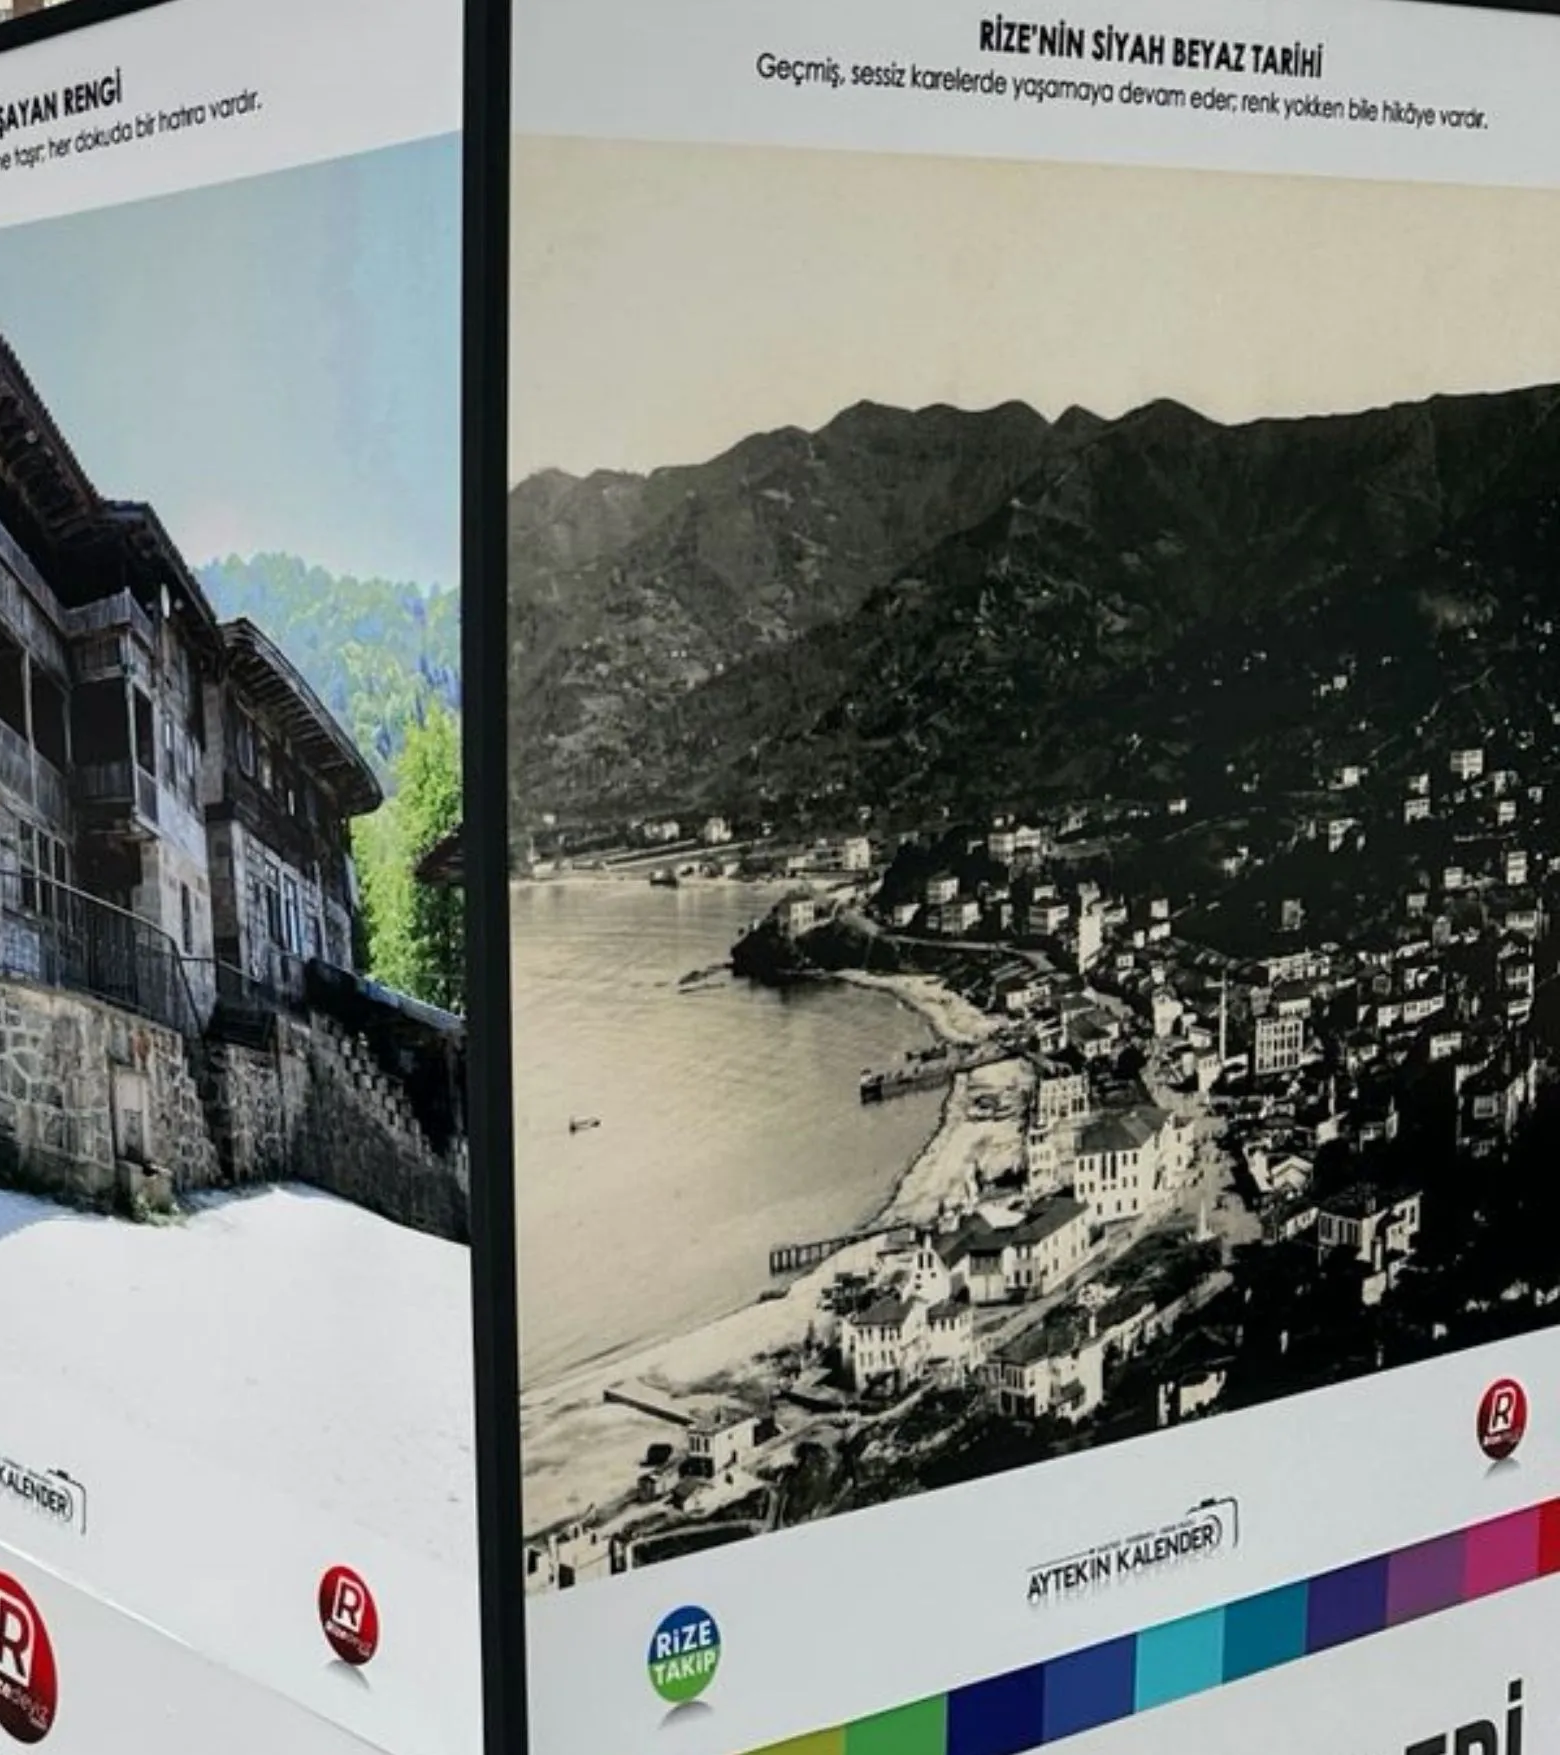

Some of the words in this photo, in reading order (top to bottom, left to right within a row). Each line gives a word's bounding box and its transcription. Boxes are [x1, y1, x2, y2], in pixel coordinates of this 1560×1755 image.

[980, 14, 1085, 60] RİZE'NİN
[1092, 24, 1165, 66] SİYAH
[1172, 37, 1246, 73] BEYAZ
[1252, 42, 1324, 78] TARİHİ
[64, 67, 122, 117] RENGİ
[756, 52, 845, 90] Geçmiş,
[851, 62, 906, 88] sessiz
[910, 64, 1007, 96] karelerde
[1012, 77, 1114, 106] yaşamaya
[1118, 80, 1187, 108] devam
[1241, 92, 1281, 116] renk
[1283, 95, 1345, 121] yokken
[1348, 97, 1379, 122] bile
[135, 110, 156, 138] bir
[1117, 1523, 1215, 1573] KALENDER
